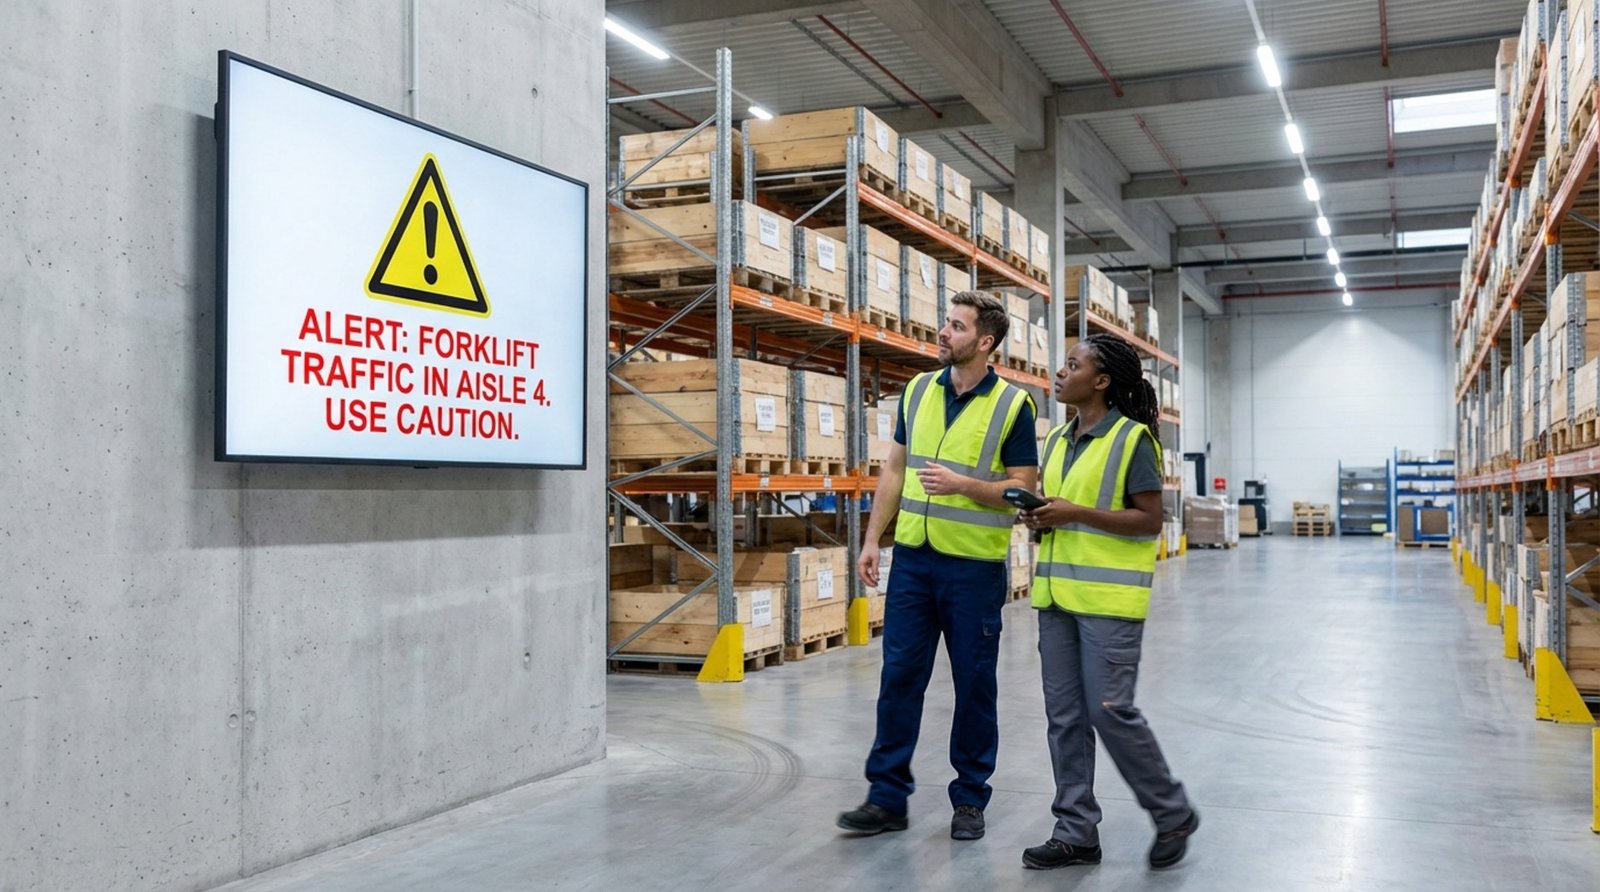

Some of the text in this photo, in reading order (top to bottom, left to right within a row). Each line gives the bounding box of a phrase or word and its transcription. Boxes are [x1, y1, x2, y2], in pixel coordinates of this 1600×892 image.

[298, 307, 540, 369] ALERT: FORKLIFT
[280, 348, 552, 407] TRAFFIC IN AISLE 4.
[325, 397, 520, 440] USE CAUTION.
